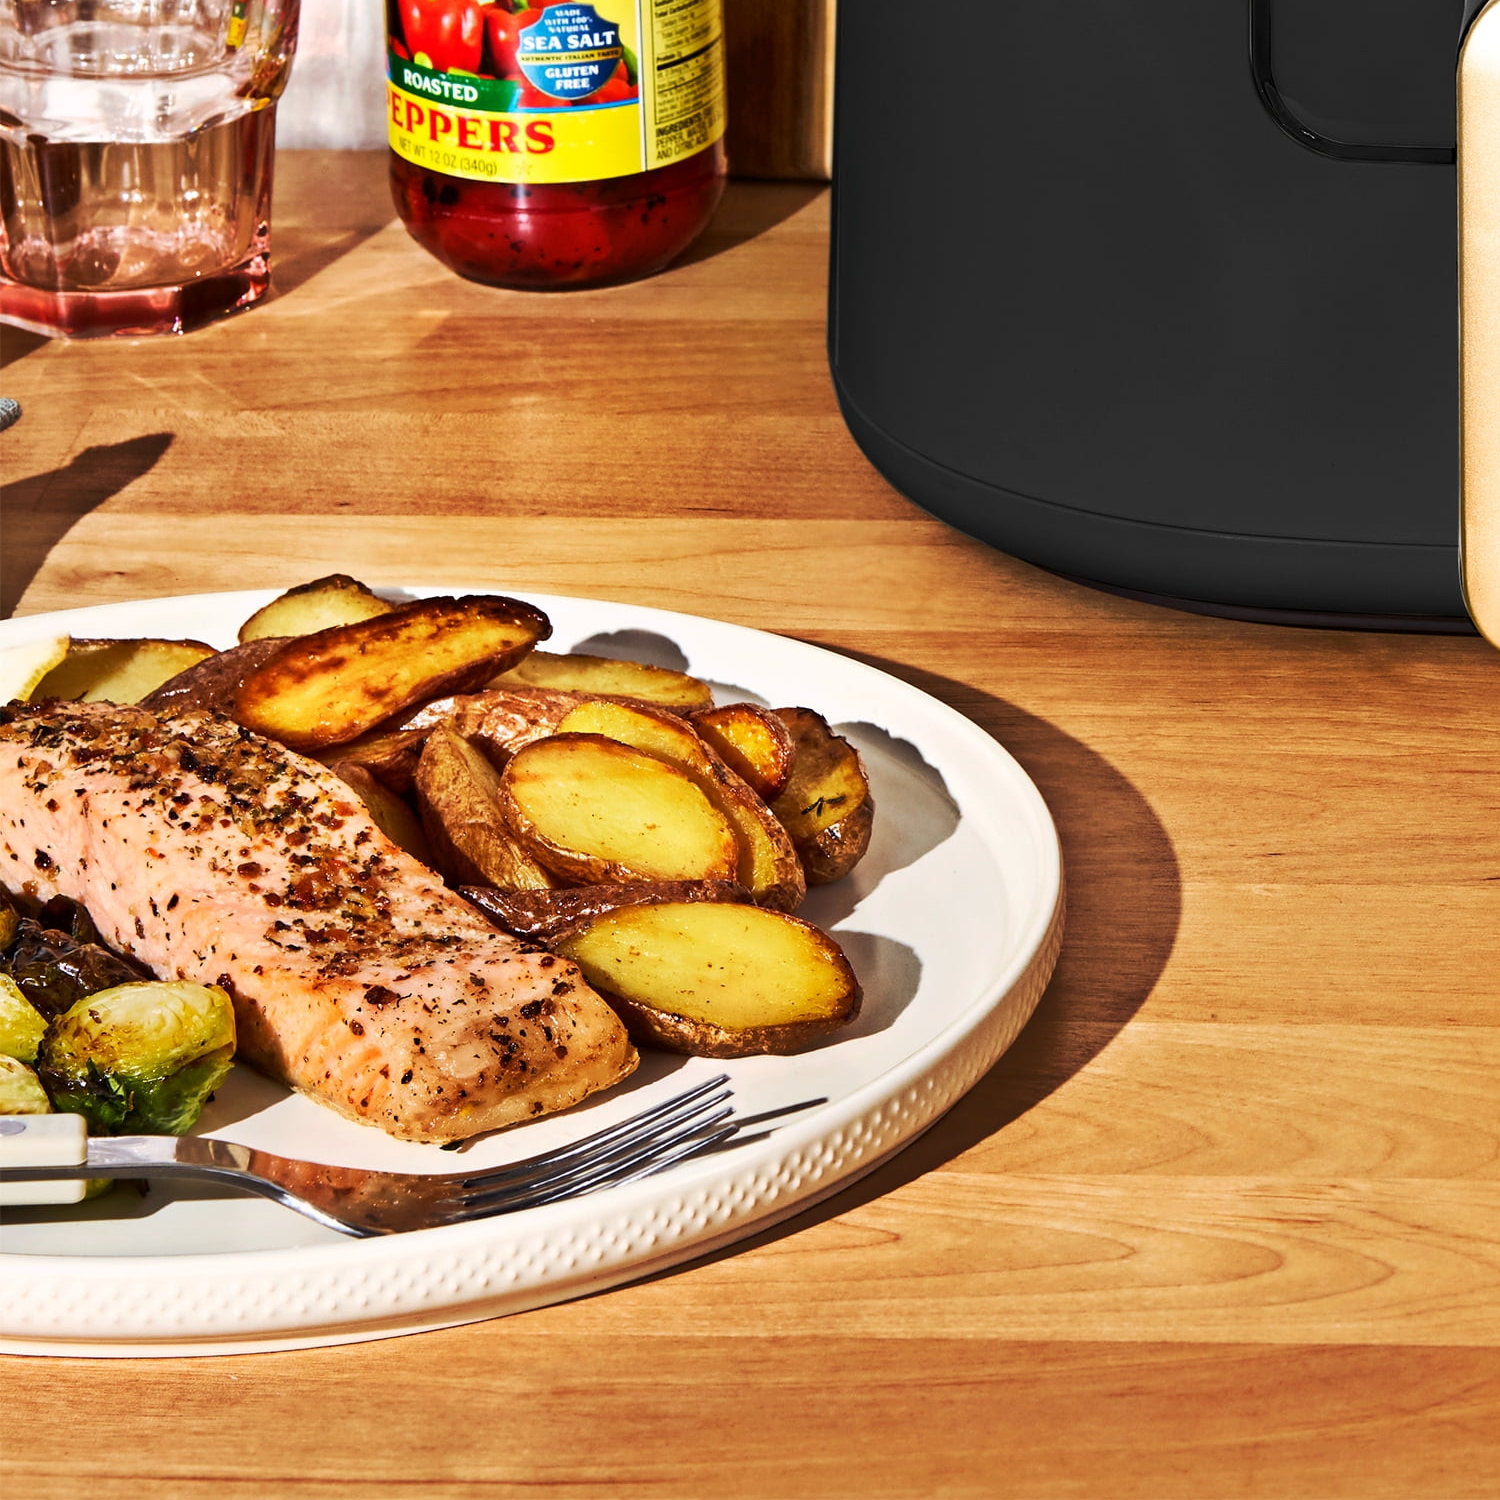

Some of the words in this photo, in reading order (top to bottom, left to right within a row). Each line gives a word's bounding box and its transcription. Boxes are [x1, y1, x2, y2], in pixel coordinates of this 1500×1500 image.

[548, 24, 589, 33] NATURAL
[523, 36, 562, 50] SEA
[567, 31, 615, 49] SALT
[544, 64, 599, 79] GLUTEN
[403, 68, 478, 102] ROASTED
[555, 78, 590, 90] FREE
[387, 83, 555, 155] EPPERS
[429, 148, 441, 164] 12
[459, 158, 498, 176] (340g)
